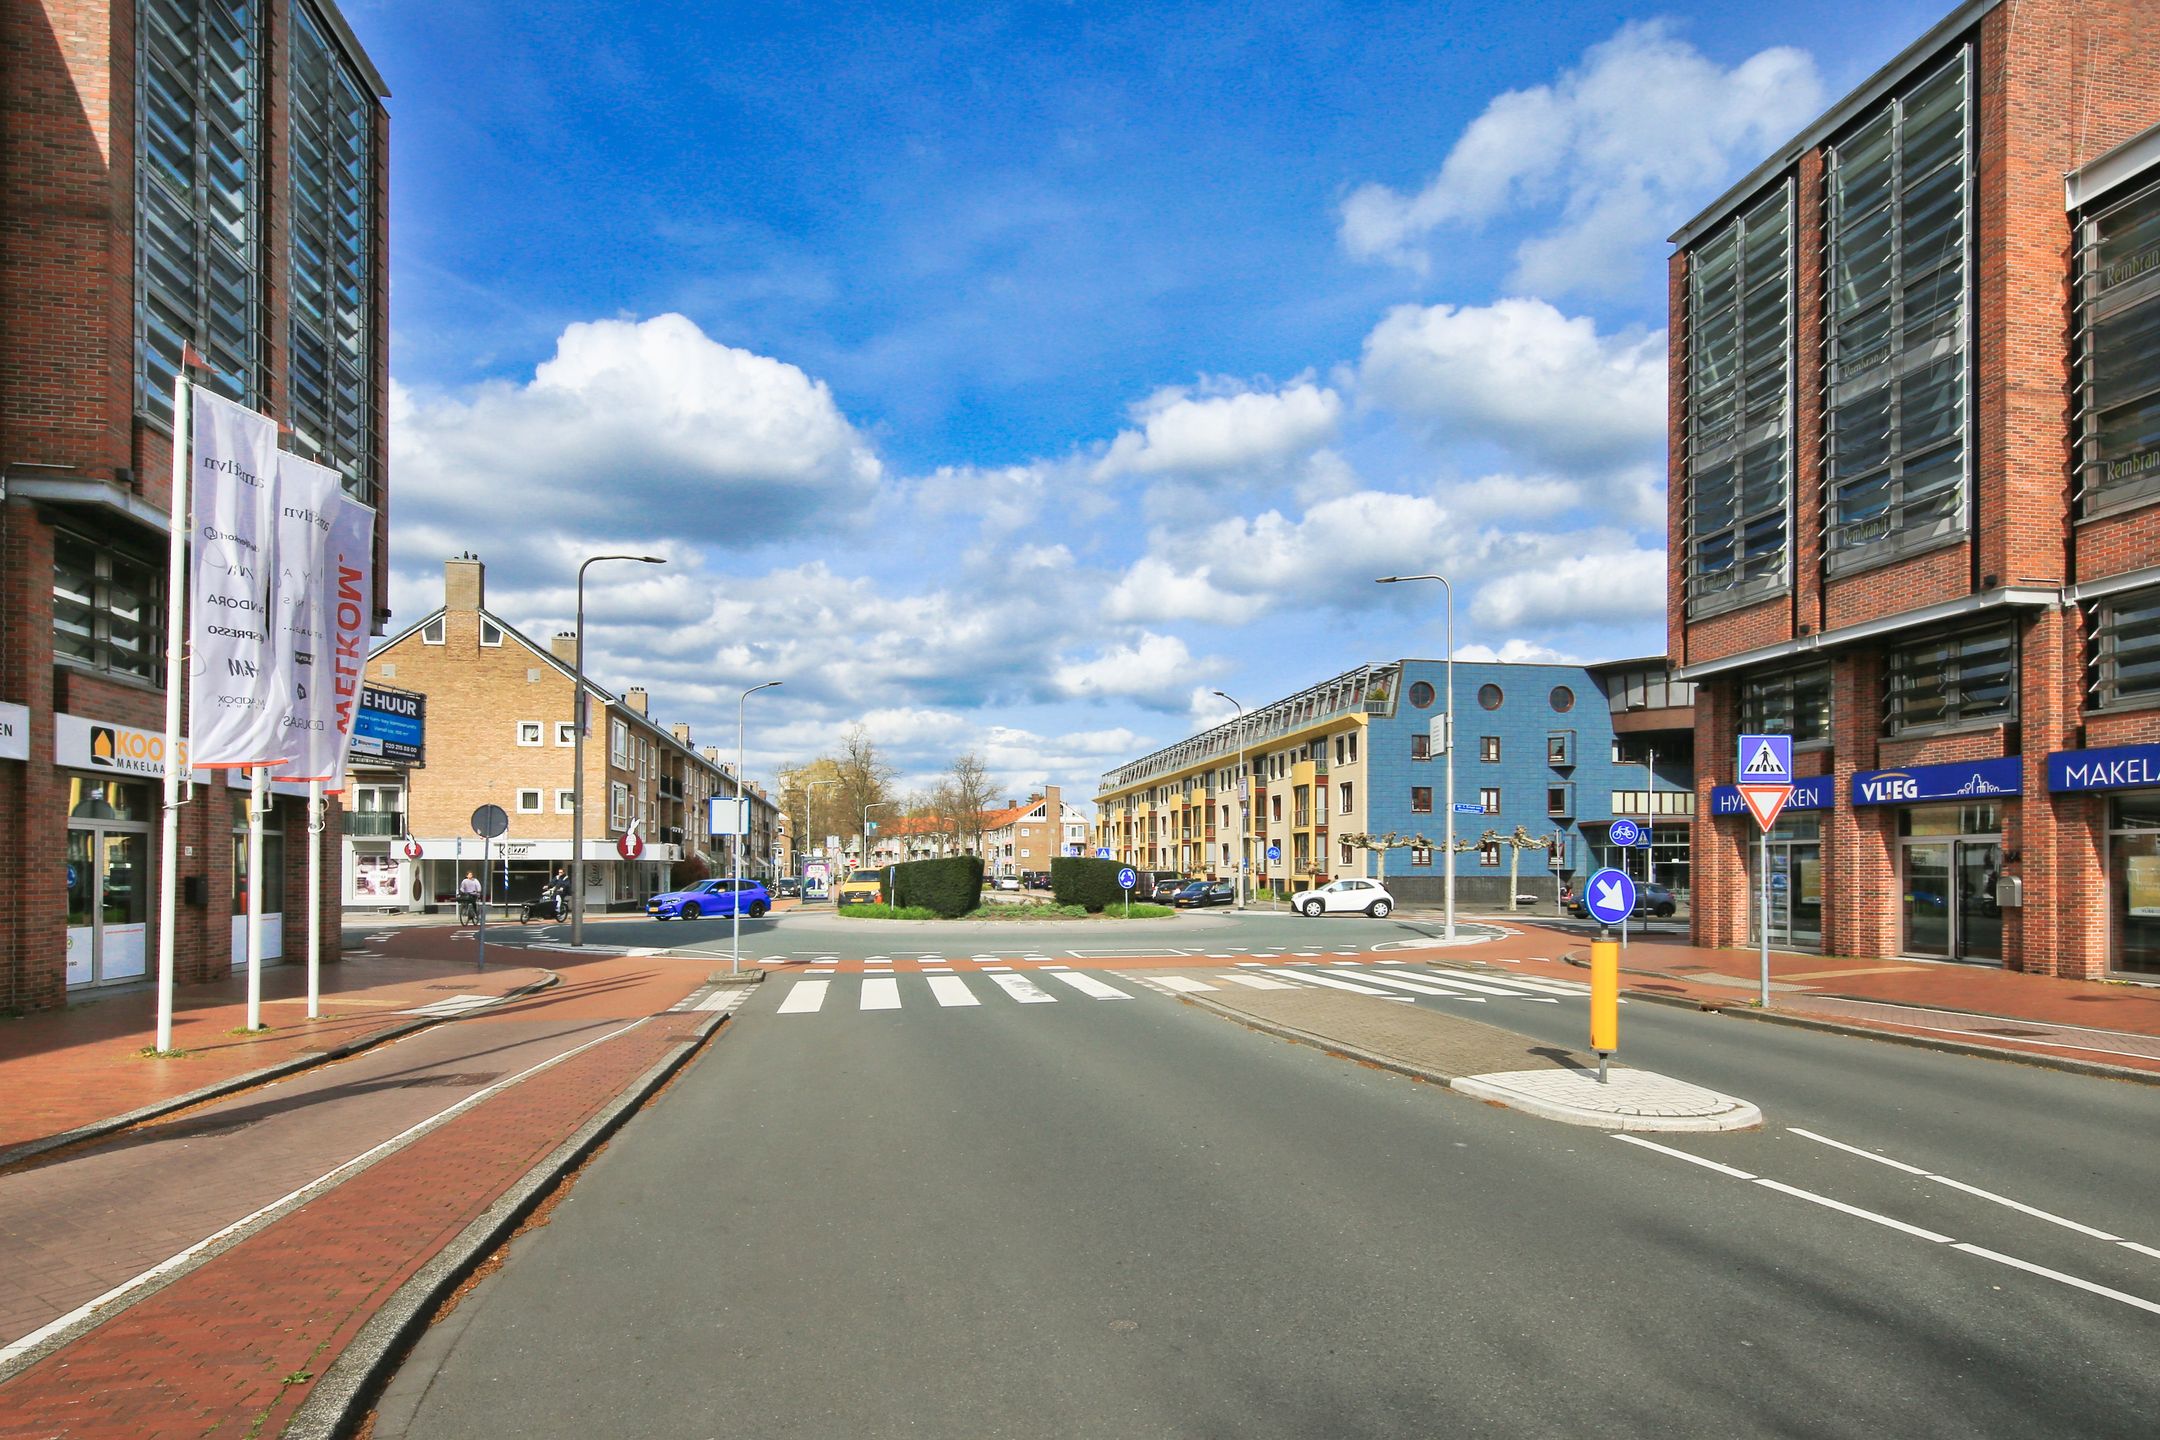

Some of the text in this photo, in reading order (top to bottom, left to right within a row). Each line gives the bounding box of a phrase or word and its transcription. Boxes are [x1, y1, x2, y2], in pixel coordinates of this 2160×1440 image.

[374, 693, 417, 717] HUUR
[116, 730, 188, 765] KOOS
[116, 758, 187, 777] MAKELAAIJ
[1720, 787, 1819, 812] HYPKEN
[1861, 779, 1918, 802] VLIEG
